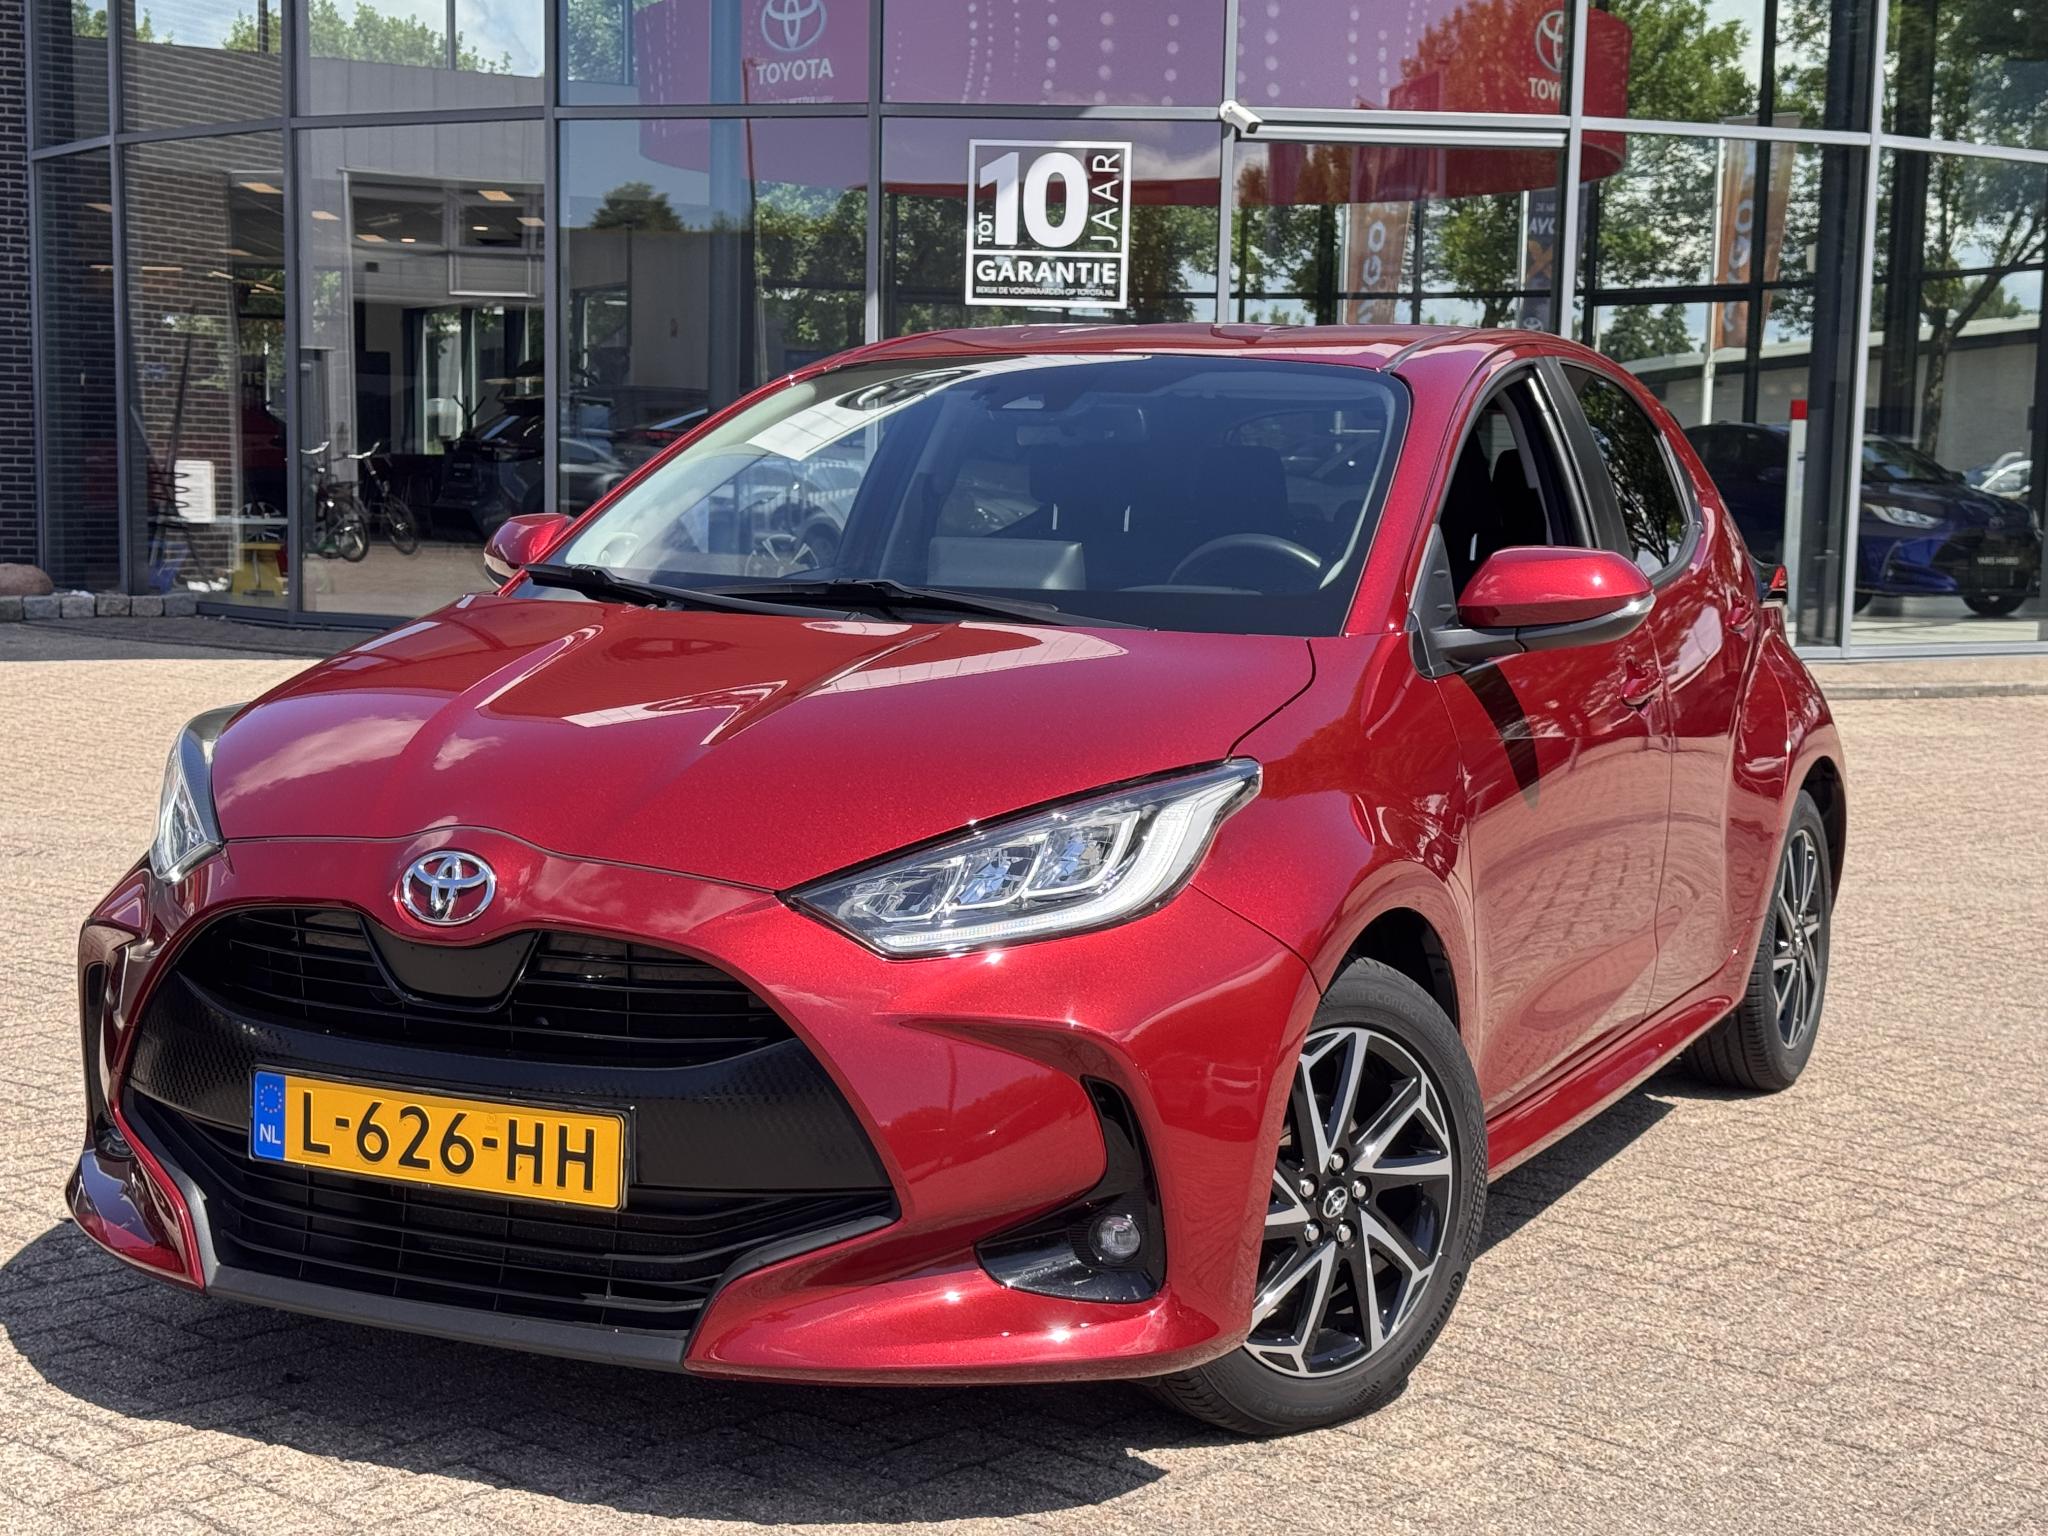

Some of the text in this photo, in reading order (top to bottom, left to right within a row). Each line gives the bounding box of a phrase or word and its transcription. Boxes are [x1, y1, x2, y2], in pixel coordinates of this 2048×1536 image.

[756, 58, 835, 85] TOYOTA
[977, 151, 1121, 249] TOT 10 JAAR
[975, 259, 1118, 285] GARANTIE
[259, 1090, 595, 1193] NL L-626-HH
